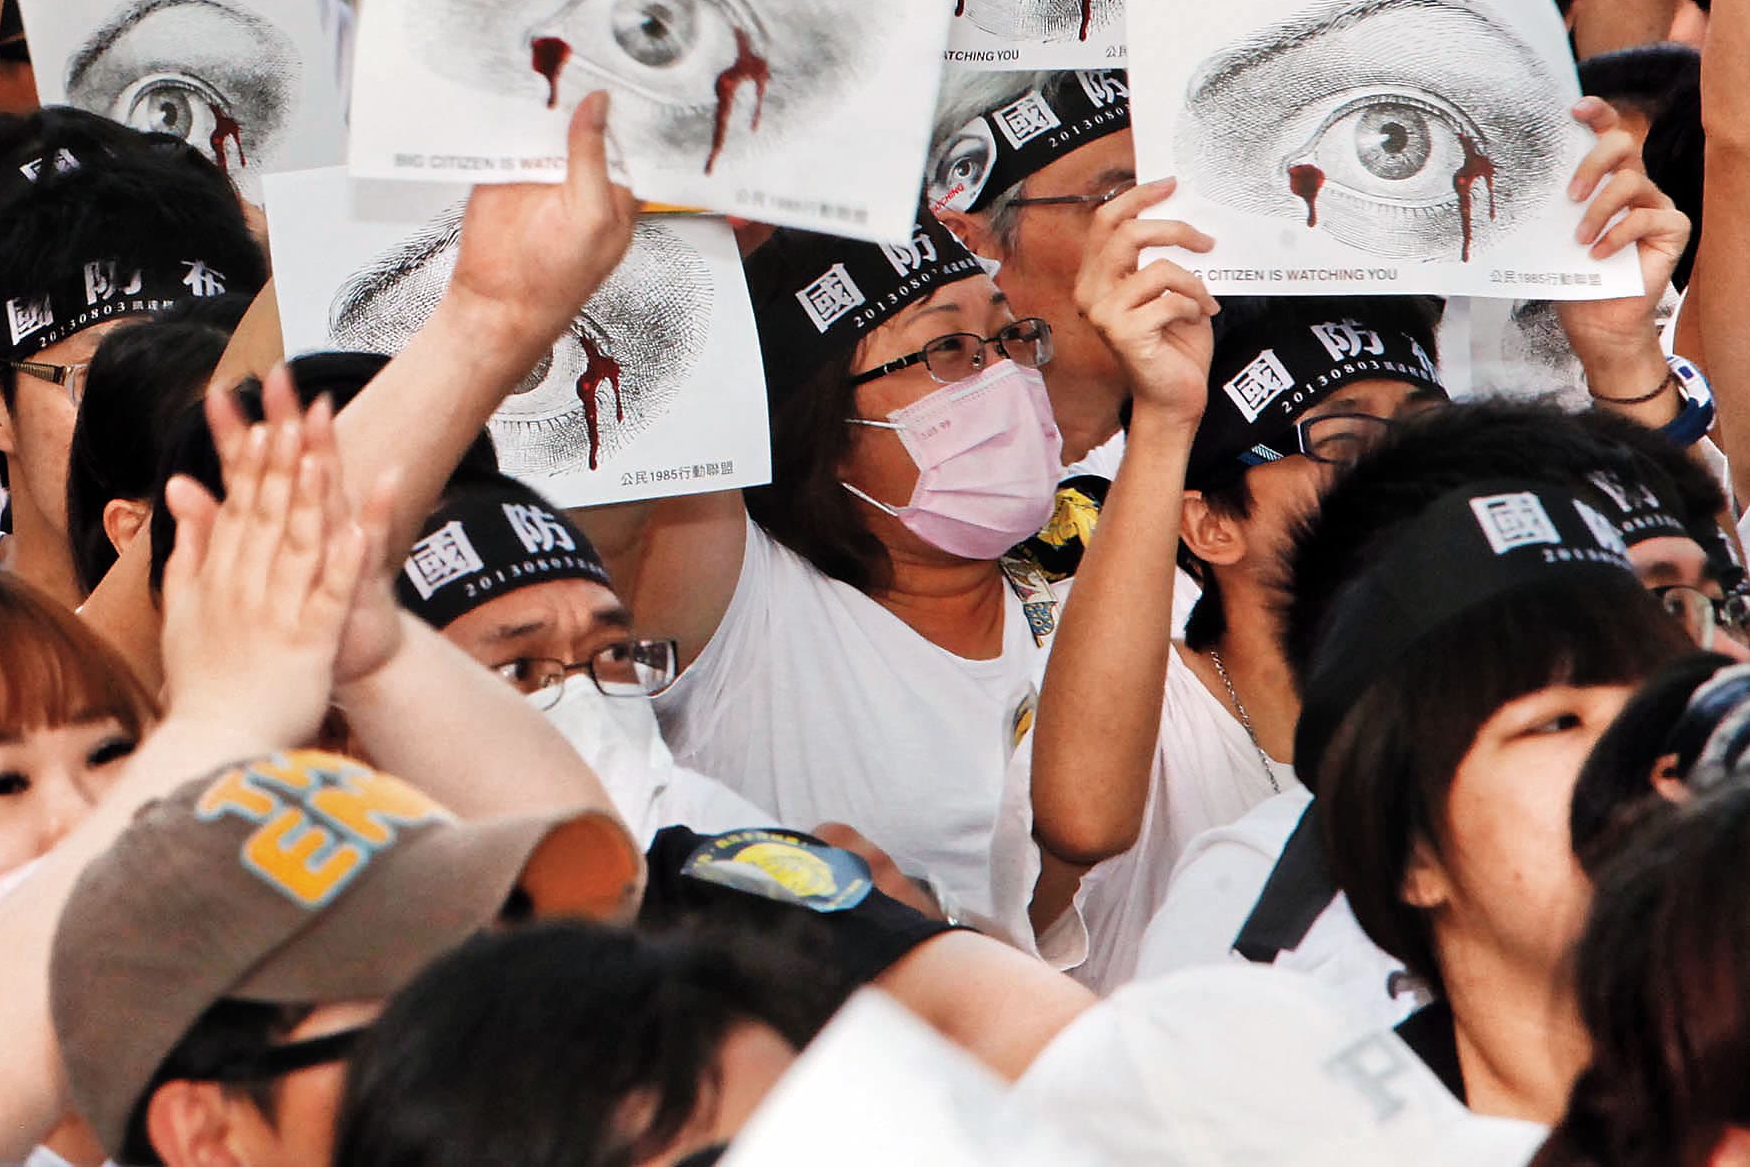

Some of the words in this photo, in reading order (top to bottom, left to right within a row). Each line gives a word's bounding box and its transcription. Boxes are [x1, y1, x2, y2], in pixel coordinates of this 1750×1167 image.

[944, 50, 994, 61] TCHING
[997, 50, 1020, 61] YOU
[1048, 103, 1130, 148] 2013080
[394, 153, 424, 167] BIG
[430, 155, 494, 170] CITIZEN
[521, 157, 568, 170] WATC
[1208, 269, 1264, 281] CITIZEN
[1270, 269, 1283, 281] IS
[1286, 269, 1365, 281] WATCHING
[1368, 268, 1398, 281] YOU
[621, 460, 733, 486] 公民1985行動聯盟
[404, 503, 576, 601] 國防
